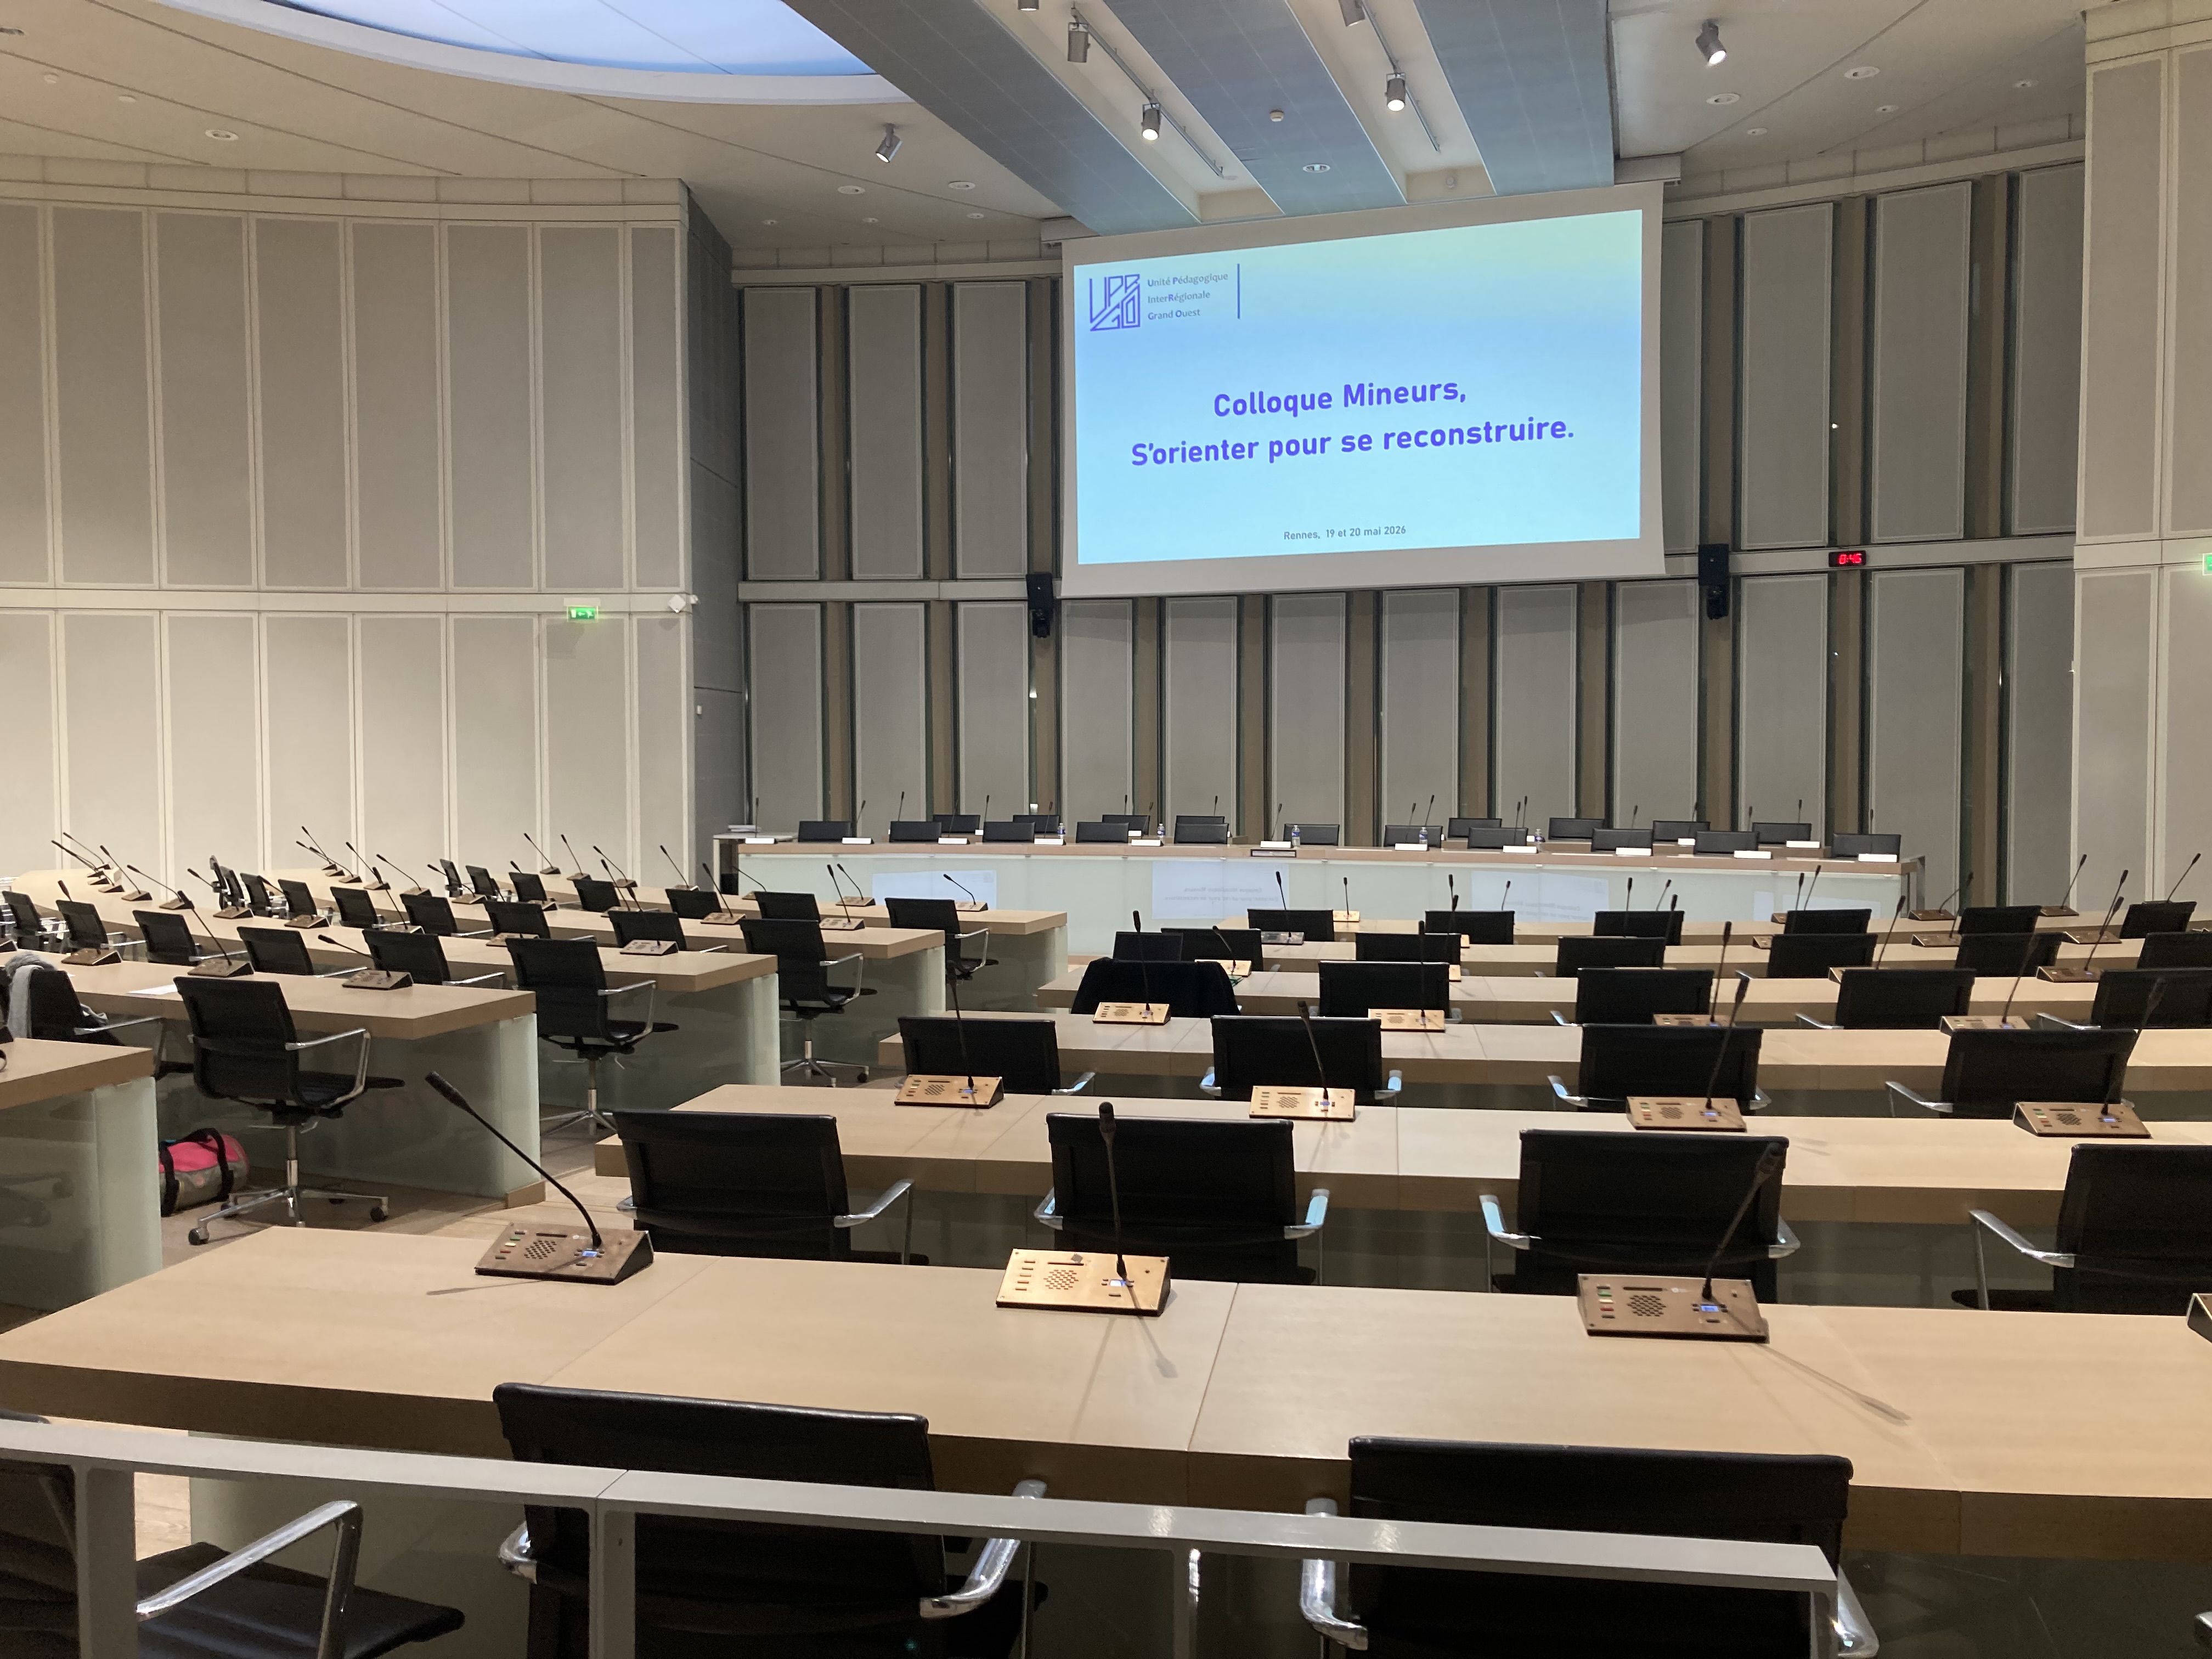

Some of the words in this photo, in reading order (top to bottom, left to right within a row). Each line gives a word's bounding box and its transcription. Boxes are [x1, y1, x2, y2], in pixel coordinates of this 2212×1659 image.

[1147, 277, 1171, 287] Unité
[1172, 273, 1228, 285] Pédagogique
[1147, 290, 1210, 304] InterRégionale
[1148, 310, 1173, 320] Grand
[1175, 308, 1201, 318] Ouest
[1214, 390, 1333, 417] Colloque
[1344, 382, 1466, 408] Mineurs,
[1268, 436, 1332, 464] pour
[1341, 433, 1373, 453] se
[1384, 416, 1574, 450] reconstruire.
[1326, 529, 1335, 538] 19
[1338, 529, 1347, 538] et
[1350, 527, 1361, 537] 20
[1364, 526, 1381, 536] mai
[1384, 525, 1406, 535] 2026
